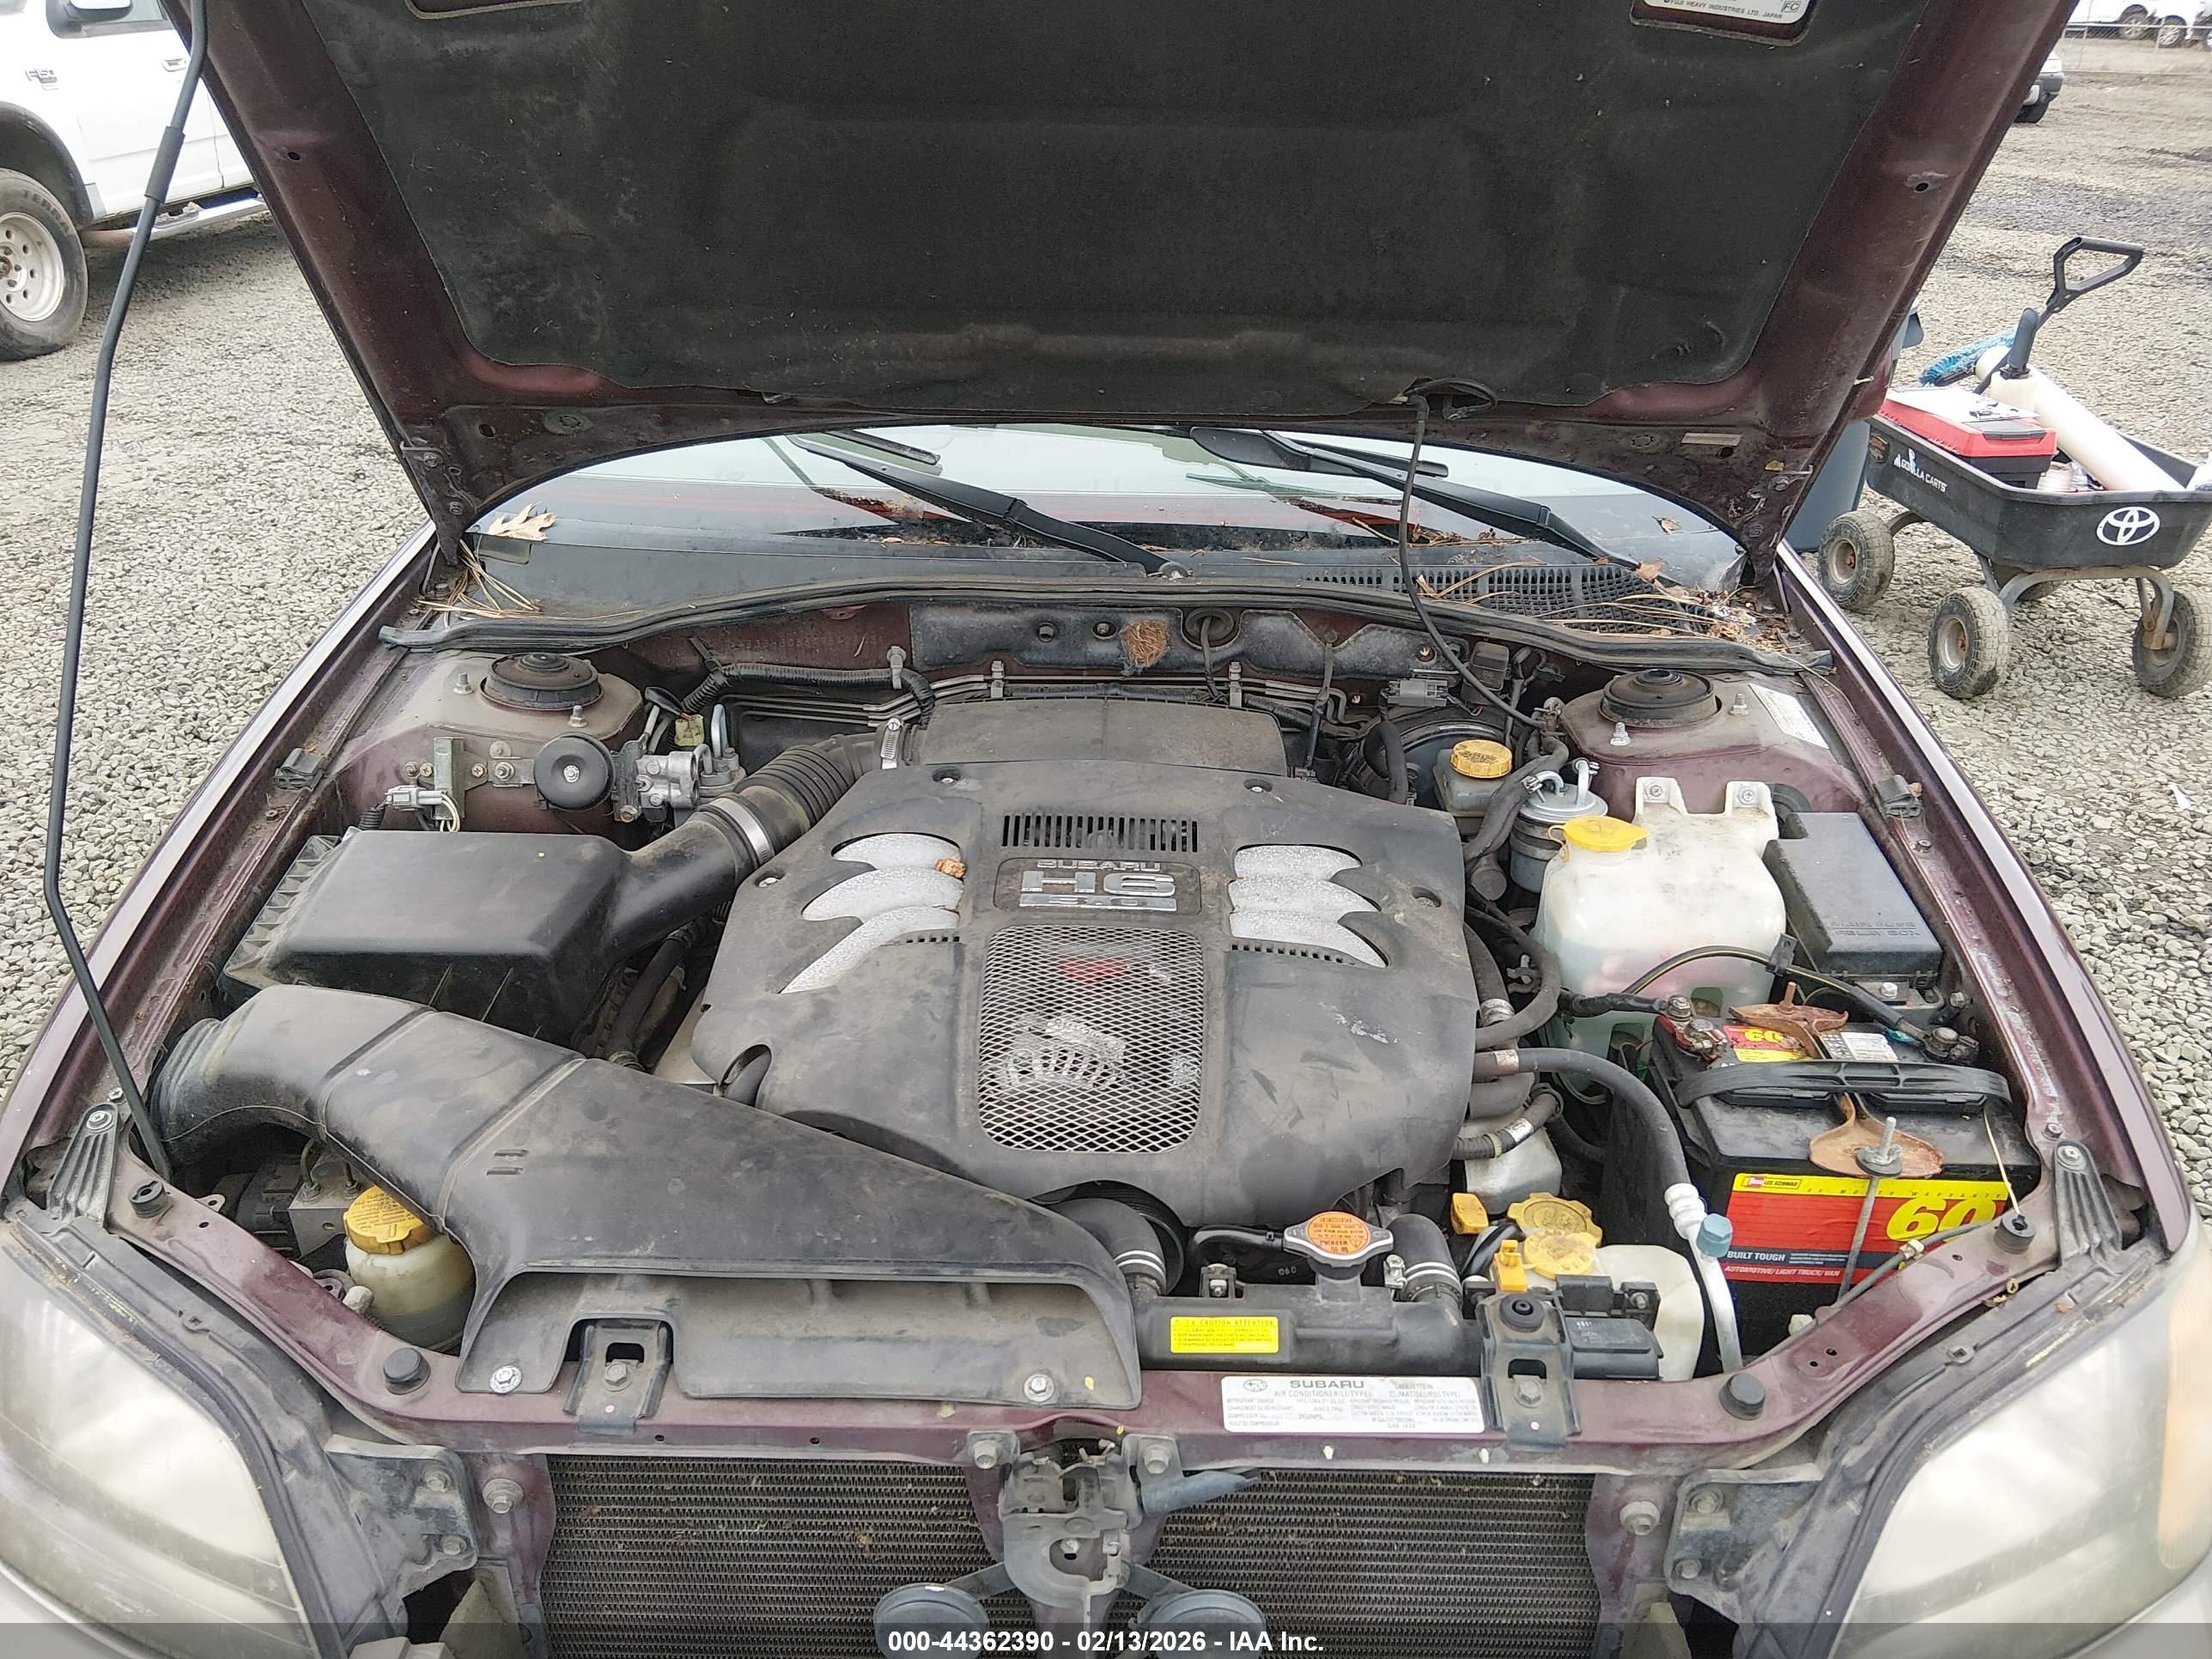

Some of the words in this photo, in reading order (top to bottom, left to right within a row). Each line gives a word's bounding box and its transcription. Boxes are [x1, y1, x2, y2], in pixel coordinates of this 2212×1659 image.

[1709, 3, 1746, 14] INDUSTRIES
[1782, 3, 1801, 12] FC
[1925, 473, 1948, 493] CARTS
[1036, 859, 1161, 872] SUBARU
[1021, 871, 1176, 897] H6
[1887, 1197, 1996, 1243] 60
[1726, 1250, 1753, 1261] BUILT
[1753, 1252, 1786, 1262] TOUGH
[1775, 1267, 1796, 1276] LIGHT
[1289, 1380, 1364, 1389] SUBARU
